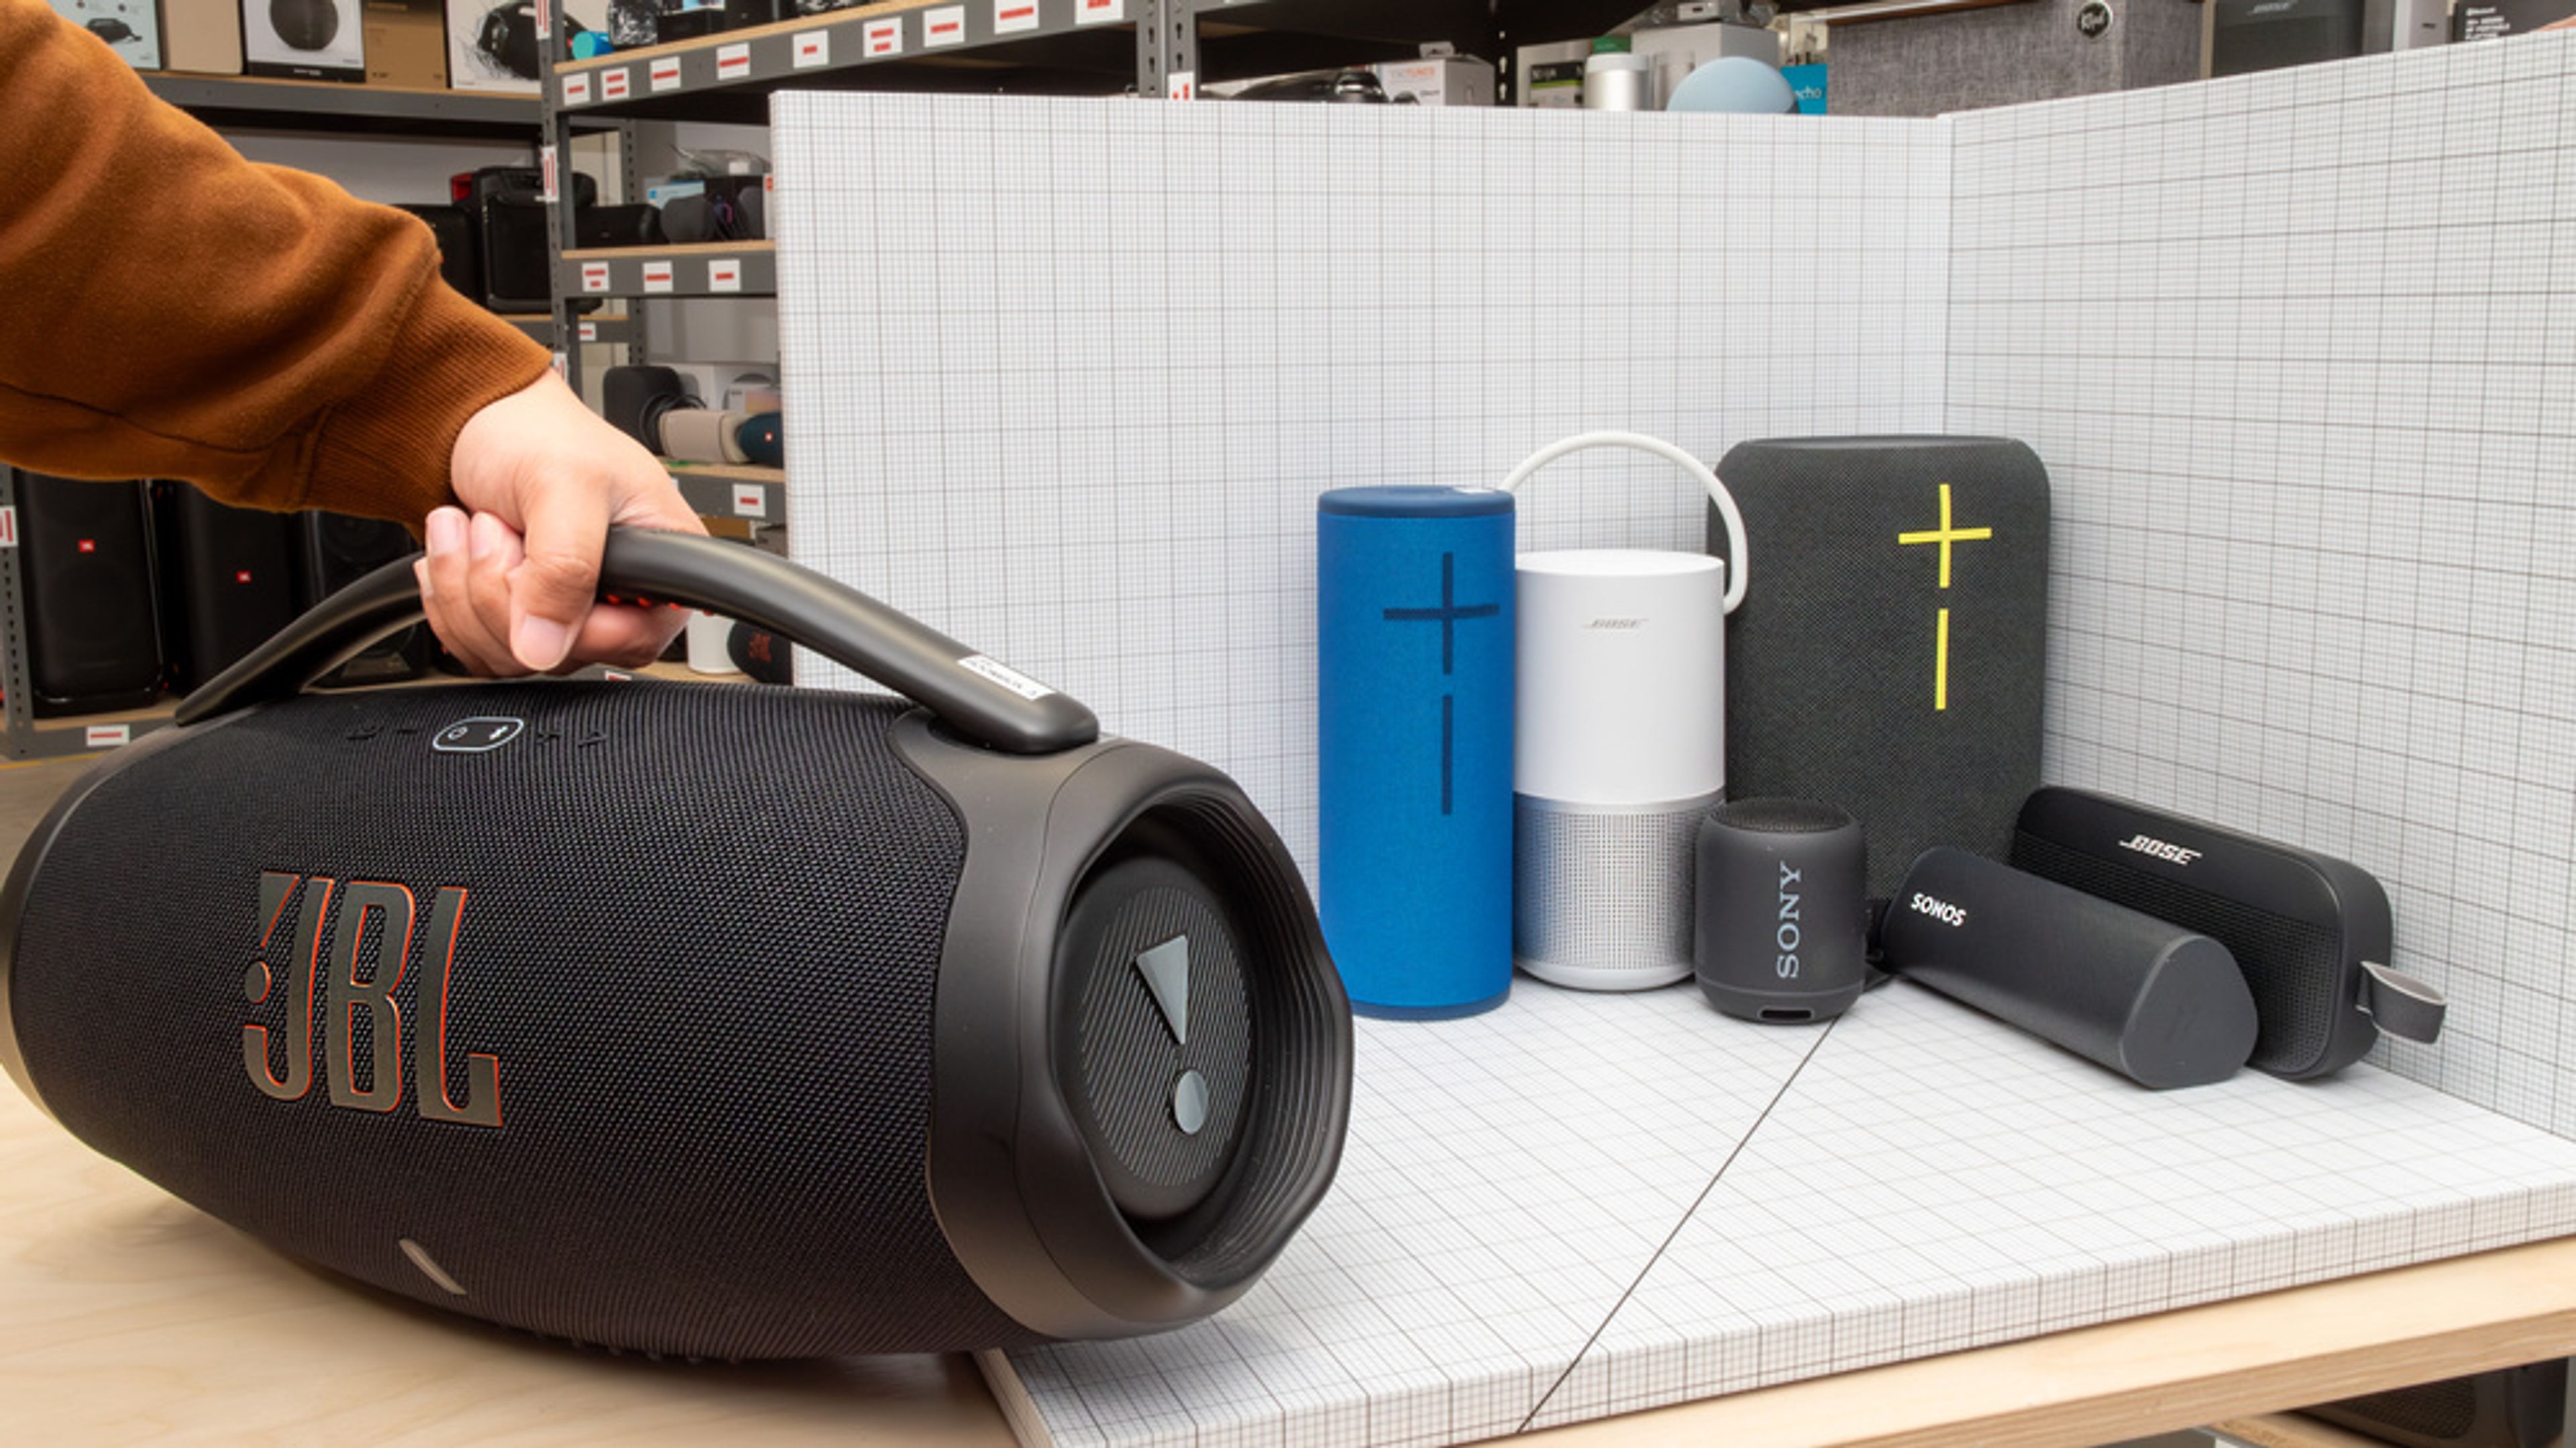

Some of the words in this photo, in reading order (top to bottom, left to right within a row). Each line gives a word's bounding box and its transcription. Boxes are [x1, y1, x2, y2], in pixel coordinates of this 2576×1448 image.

[2118, 833, 2202, 866] BOSE
[1776, 860, 1803, 979] SONY
[1911, 892, 1967, 926] SONOS
[244, 871, 504, 1128] JBL
